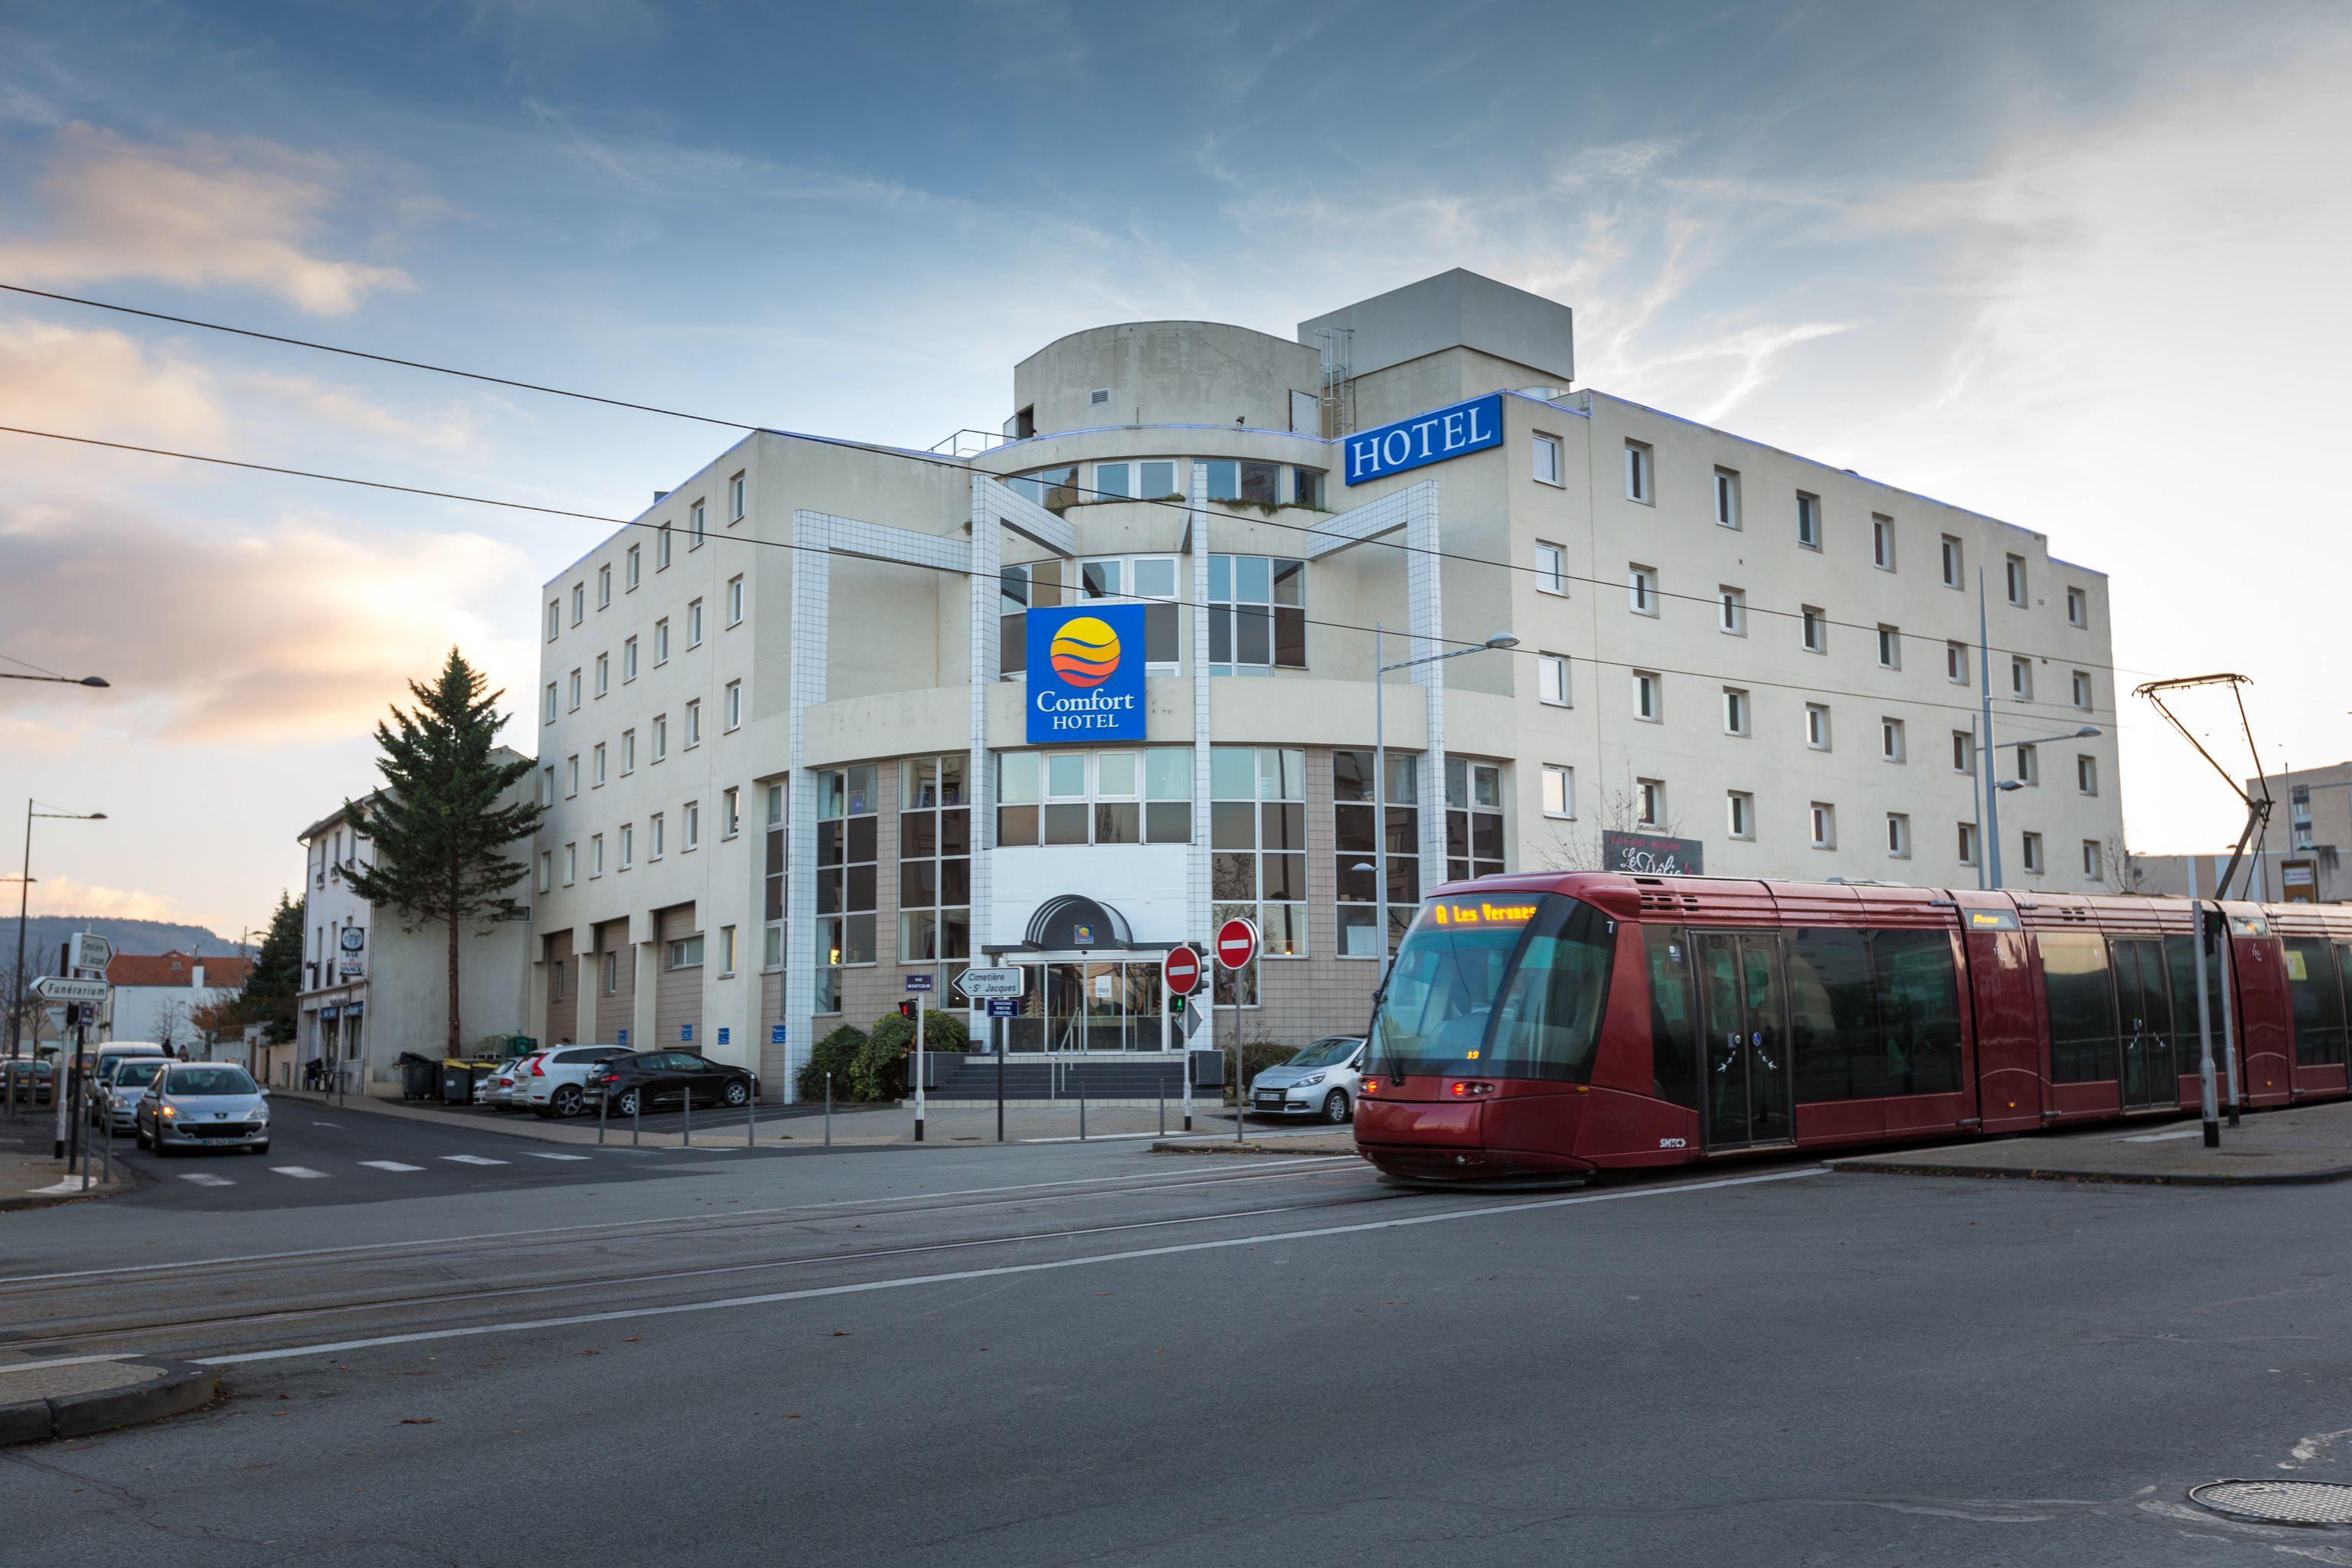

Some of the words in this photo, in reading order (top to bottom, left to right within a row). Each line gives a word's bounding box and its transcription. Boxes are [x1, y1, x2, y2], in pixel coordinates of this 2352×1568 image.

[1352, 407, 1491, 478] HOTEL
[1037, 688, 1135, 712] Comfort
[1053, 714, 1119, 730] HOTEL
[1436, 905, 1448, 924] A
[1453, 905, 1478, 922] Les
[1481, 903, 1537, 921] Vergnes
[969, 972, 1004, 982] Cimetière
[47, 982, 106, 996] Funérarium
[985, 984, 1016, 995] Jacques
